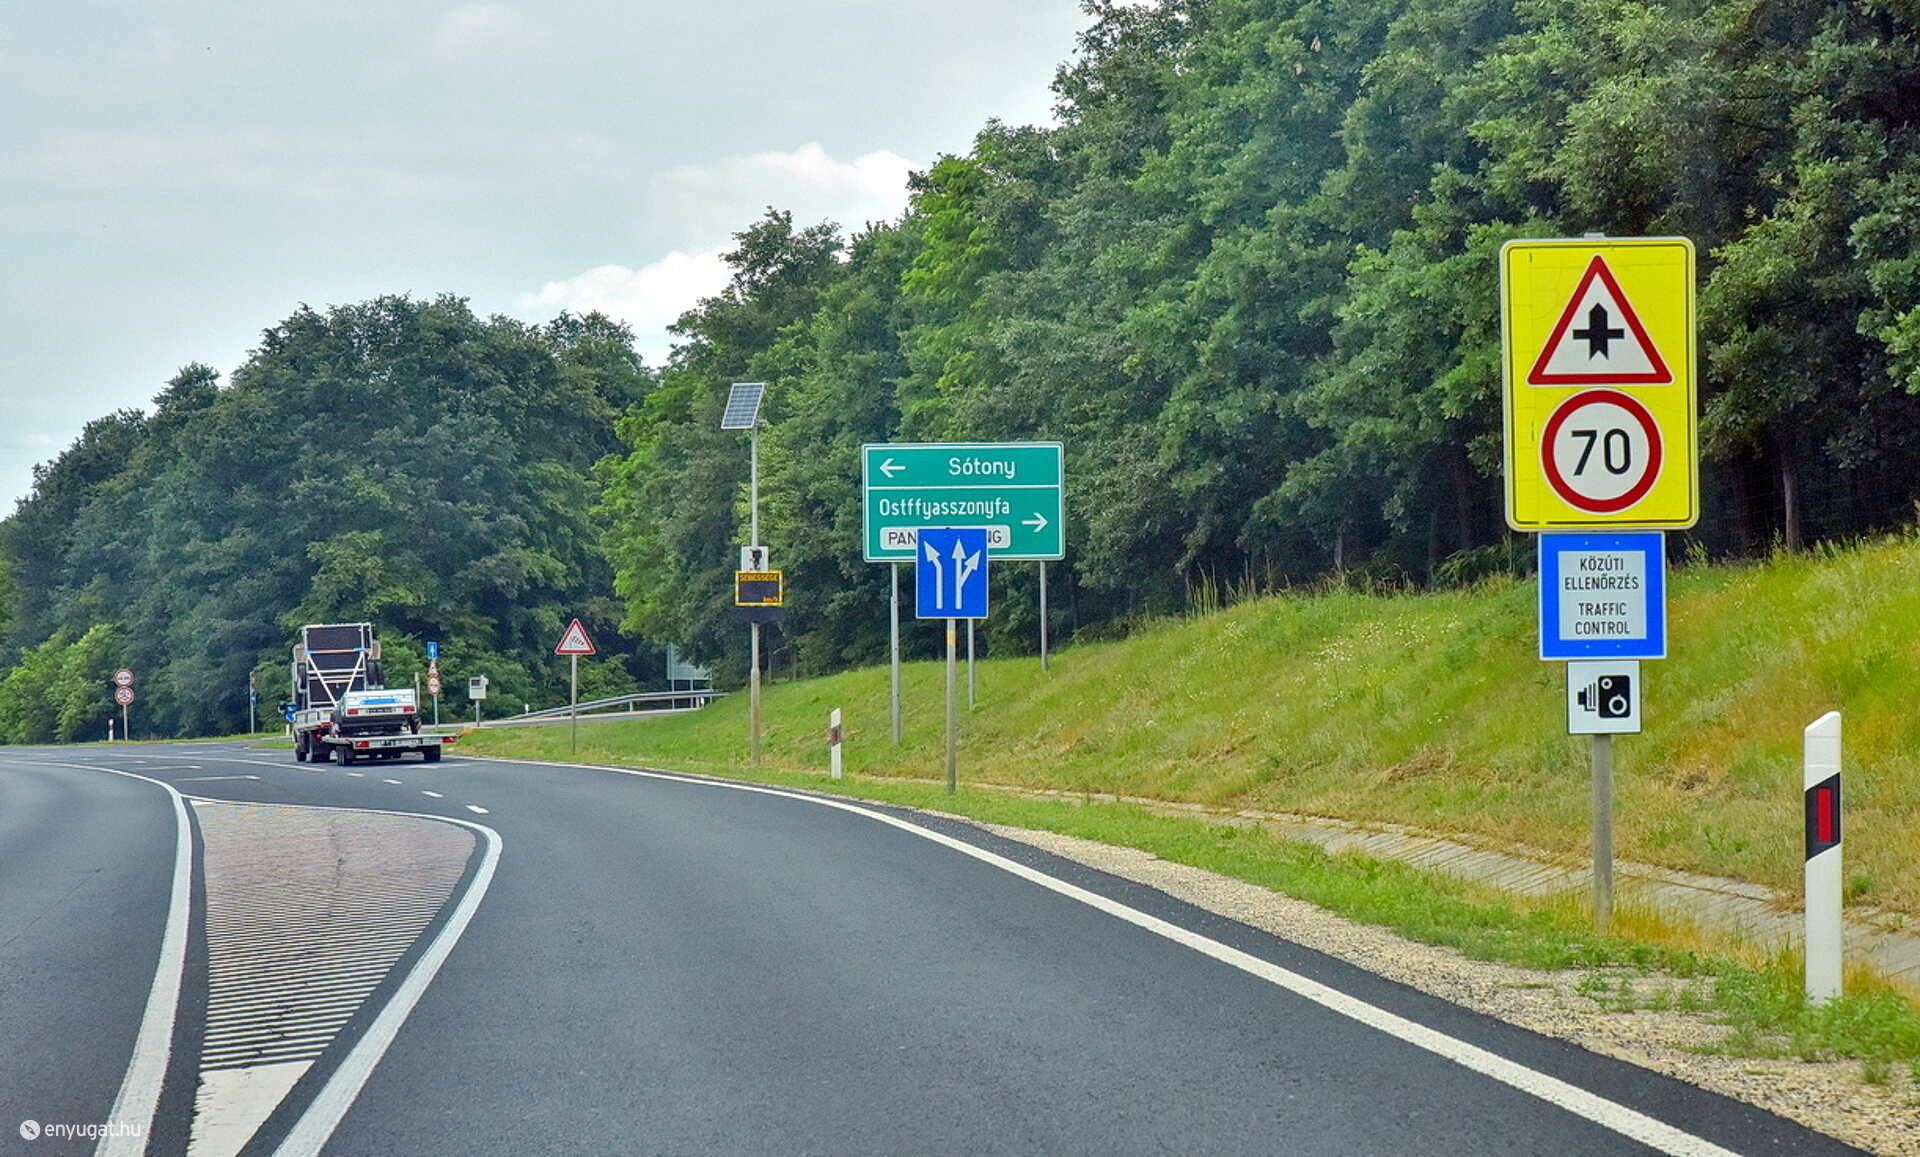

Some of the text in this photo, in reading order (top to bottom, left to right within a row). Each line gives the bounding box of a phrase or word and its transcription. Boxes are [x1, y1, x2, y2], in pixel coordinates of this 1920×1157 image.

[1571, 428, 1632, 476] 70
[948, 457, 1016, 479] Sótony
[879, 497, 1011, 520] Ostffyasszonyfa
[1579, 555, 1624, 572] KÖZÚTI
[1564, 573, 1640, 590] ELLENŐRZÉS
[1578, 602, 1627, 616] TRAFFIC
[1575, 621, 1631, 635] CONTROL
